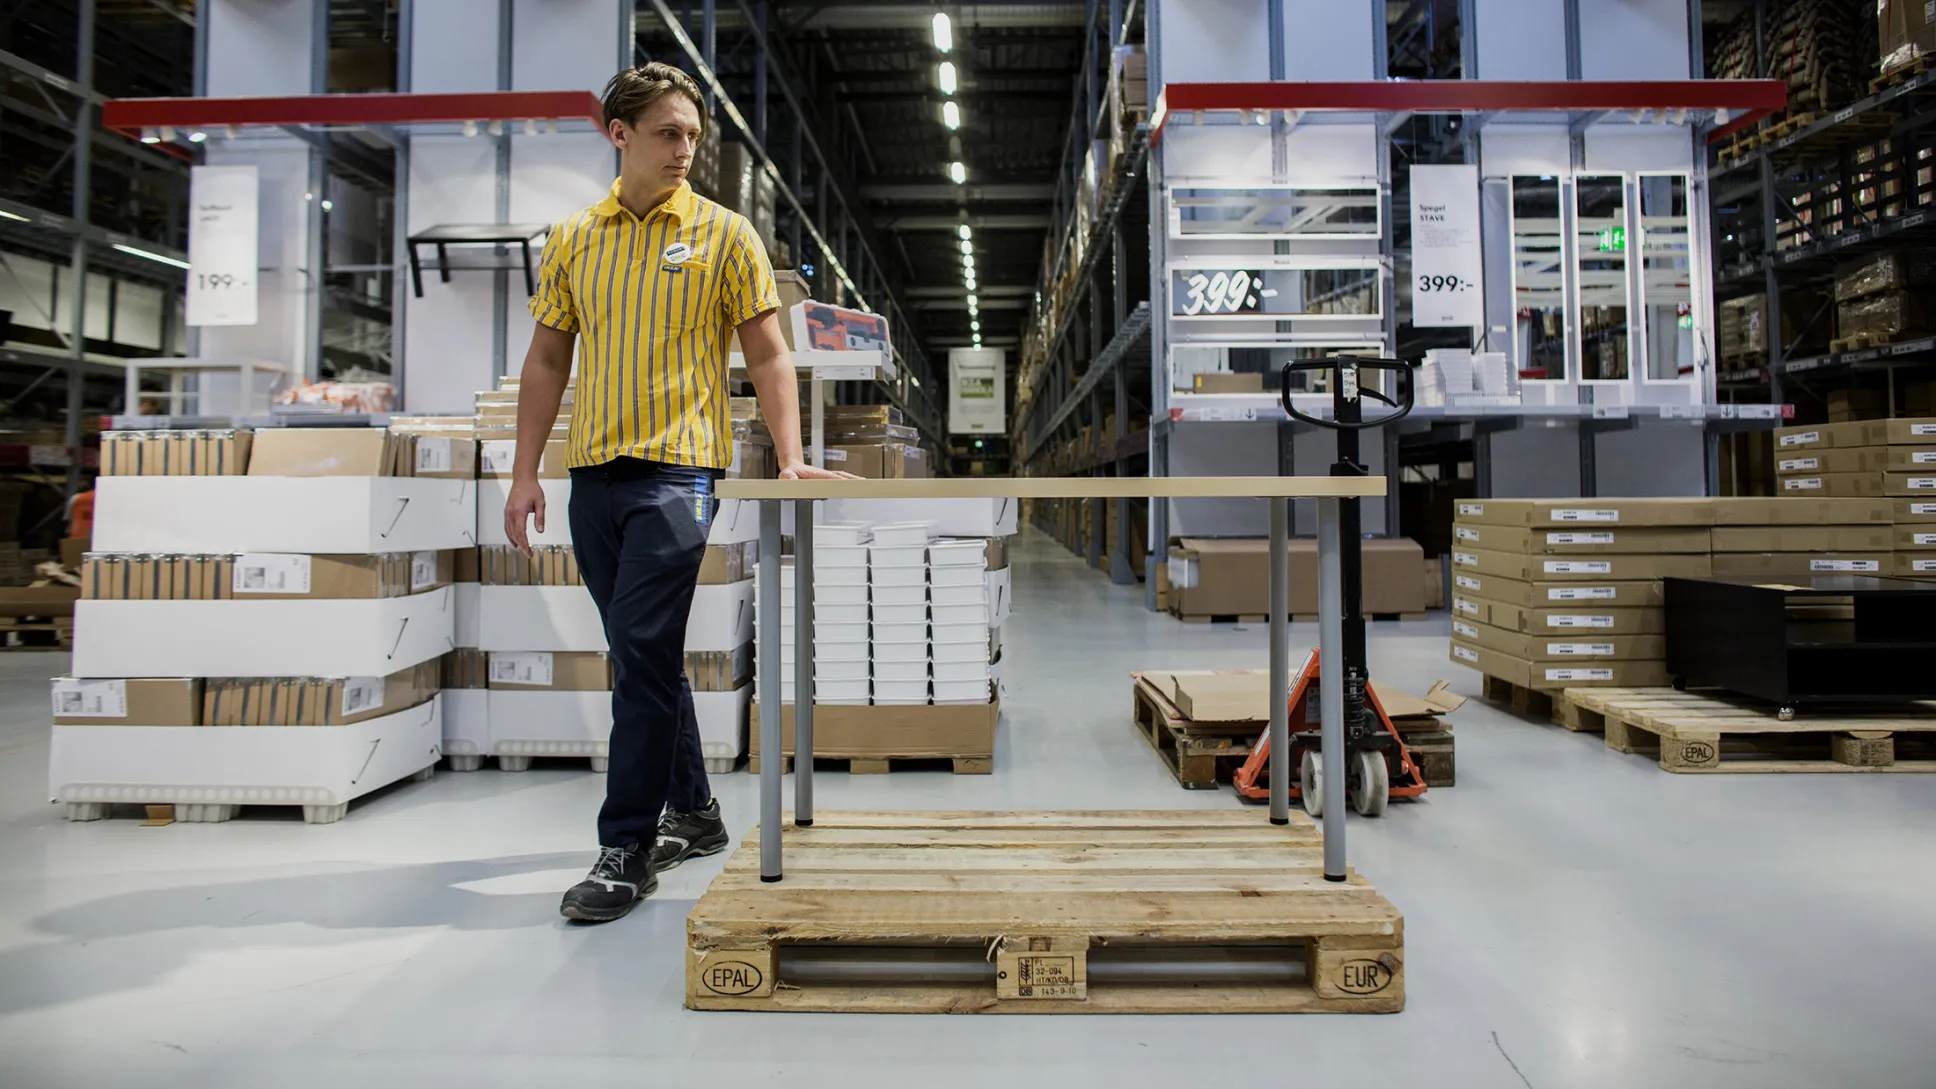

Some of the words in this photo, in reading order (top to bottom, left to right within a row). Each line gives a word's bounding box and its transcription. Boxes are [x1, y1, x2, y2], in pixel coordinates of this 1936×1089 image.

[1419, 204, 1446, 212] Spegel
[1419, 275, 1474, 292] 399:-
[1182, 270, 1278, 315] 399:-
[1685, 747, 1709, 758] EPAL
[713, 969, 754, 987] EPAL
[1344, 966, 1378, 987] EUR
